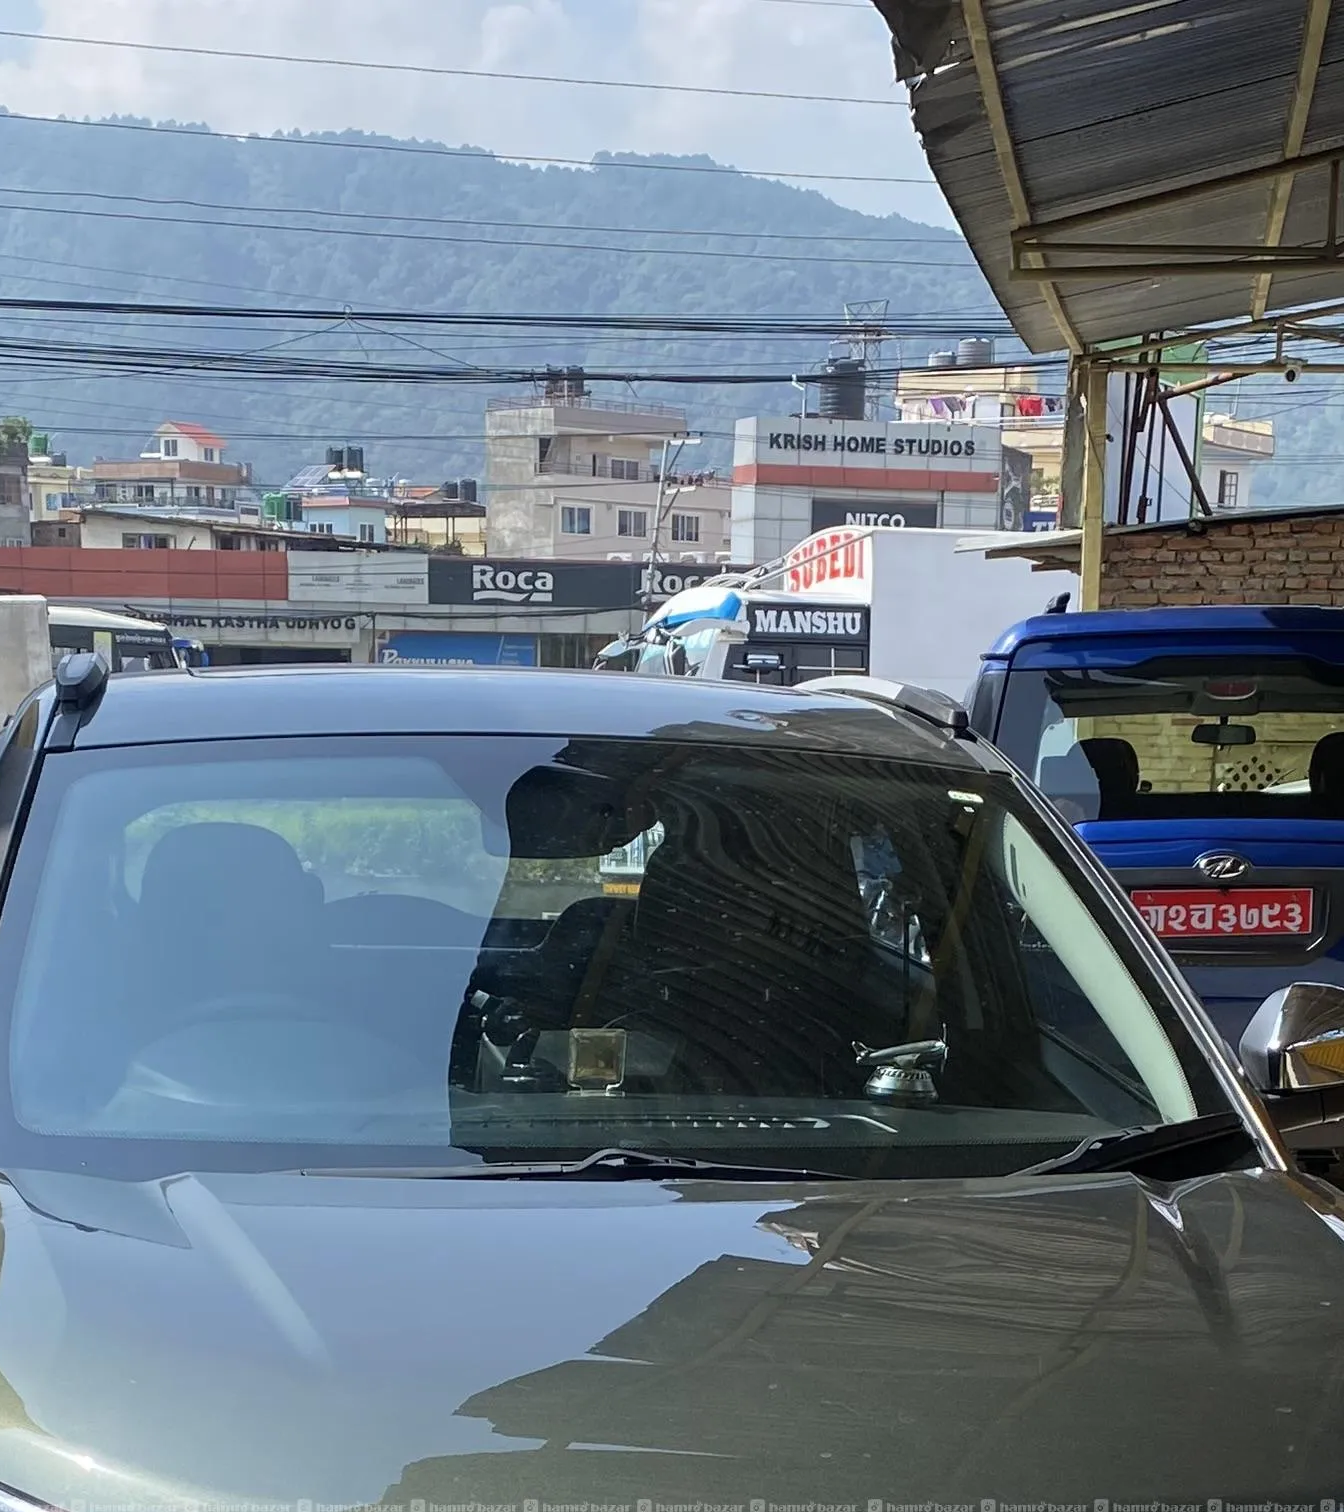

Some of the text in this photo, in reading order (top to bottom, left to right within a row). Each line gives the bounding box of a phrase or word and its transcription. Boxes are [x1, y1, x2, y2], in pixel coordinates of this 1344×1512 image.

[769, 432, 975, 456] KRISH HOME STUDIOS
[845, 512, 906, 528] NITCO
[789, 532, 865, 593] SUBEDI
[472, 564, 554, 590] Roca
[755, 609, 861, 635] MANSHU
